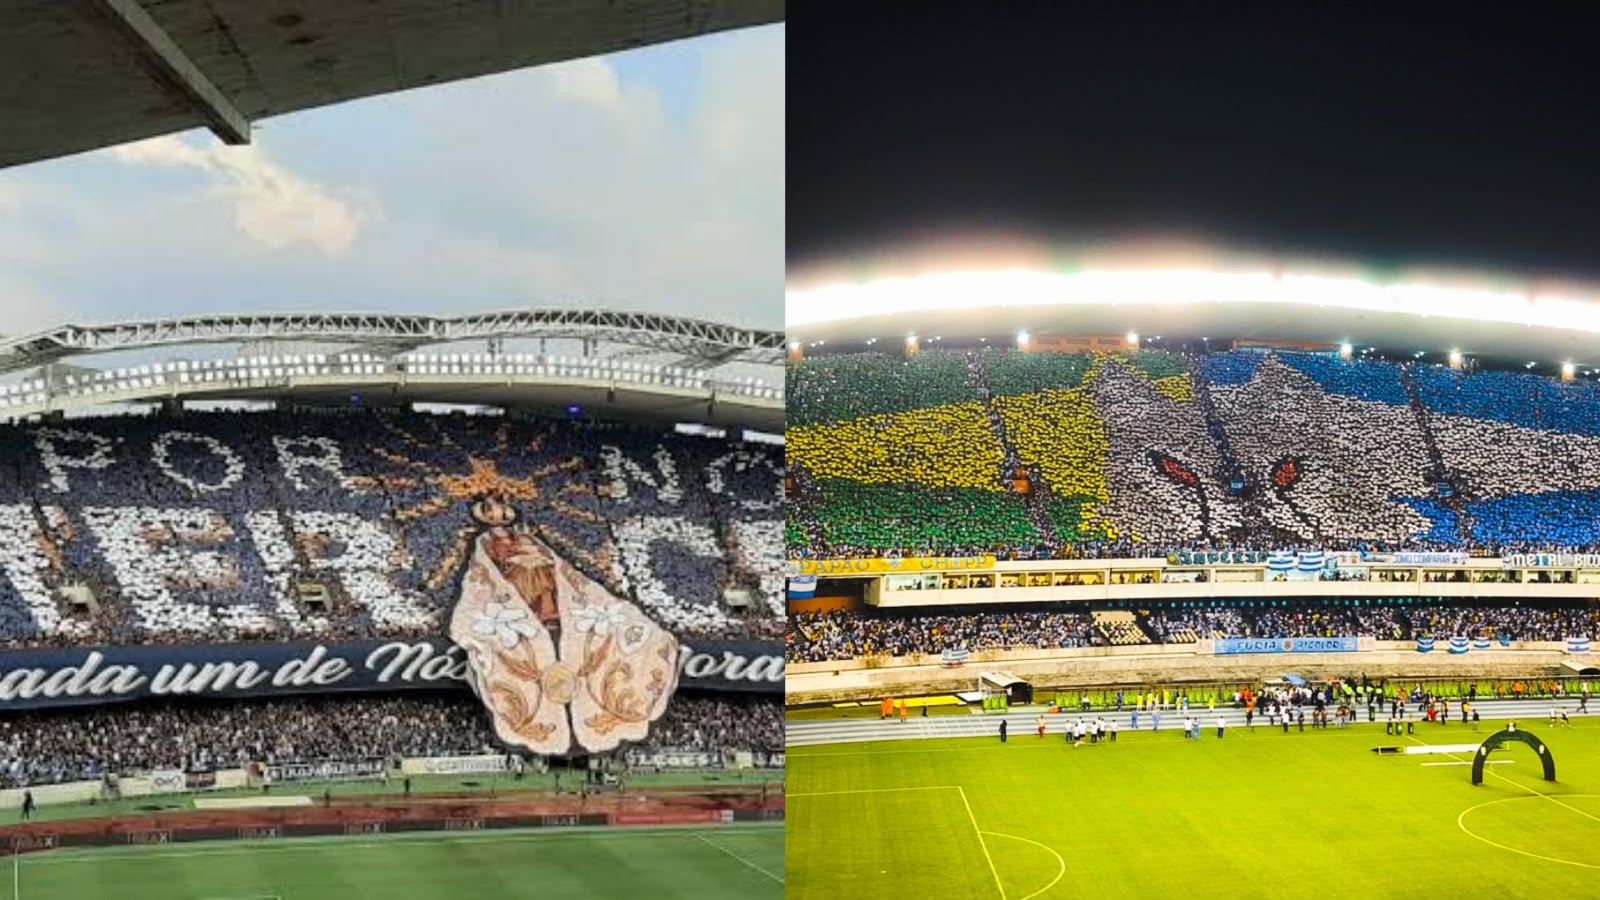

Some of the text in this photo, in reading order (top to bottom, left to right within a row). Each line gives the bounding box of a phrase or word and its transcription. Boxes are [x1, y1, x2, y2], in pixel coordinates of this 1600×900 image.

[28, 428, 370, 497] POR
[0, 652, 146, 699] ada
[151, 661, 269, 694] um
[272, 646, 352, 685] de
[680, 645, 785, 682] ora
